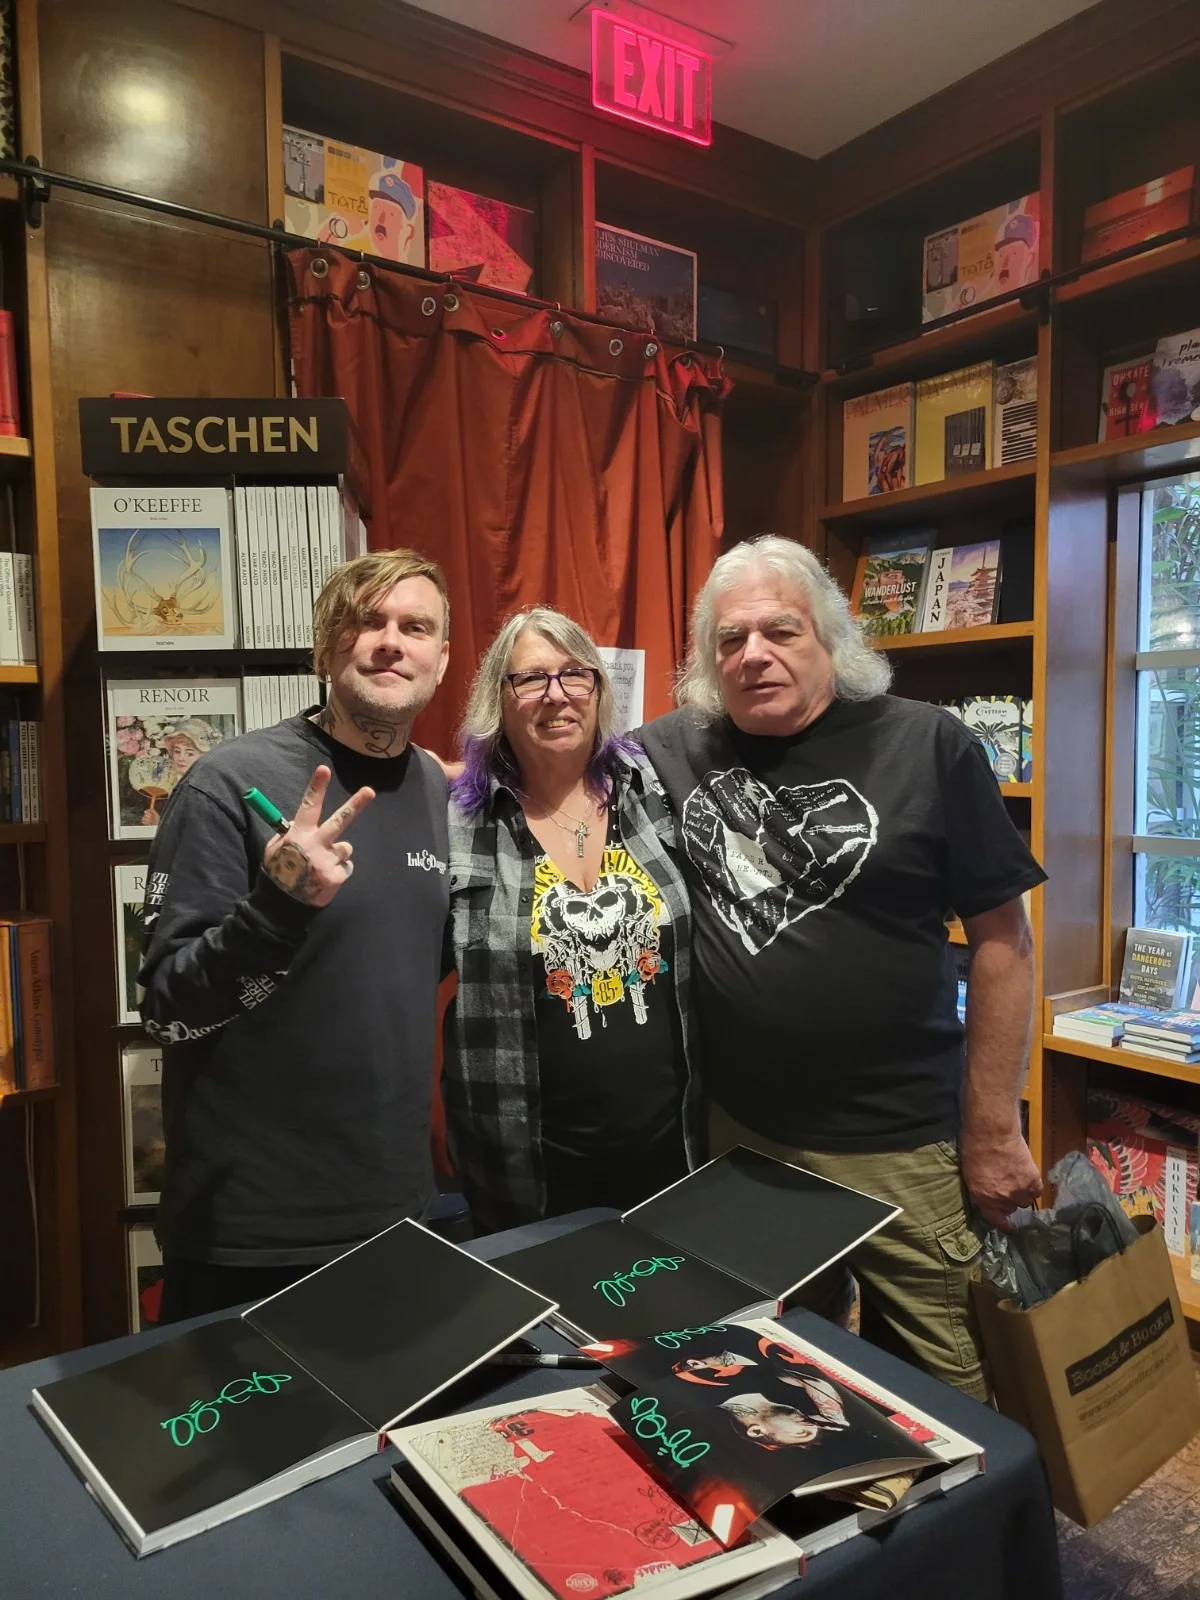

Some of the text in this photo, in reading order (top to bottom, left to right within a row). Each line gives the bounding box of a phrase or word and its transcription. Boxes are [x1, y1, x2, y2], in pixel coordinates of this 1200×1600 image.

[613, 25, 700, 129] EXIT
[596, 240, 638, 259] DERNISM
[618, 237, 659, 257] SHULMAN
[596, 249, 650, 272] DISCOVERED
[110, 416, 319, 454] TASCHEN
[863, 580, 918, 598] WANDERLUST
[929, 556, 946, 623] JAPAN
[139, 688, 210, 704] RENOIR
[1131, 952, 1172, 968] DANGEROUS
[1134, 943, 1147, 952] THE
[1148, 945, 1165, 957] YEAR
[30, 950, 39, 976] Anna
[1141, 964, 1158, 976] DAYS
[31, 977, 43, 1010] Atkins
[599, 980, 616, 1003] 85
[1171, 1161, 1181, 1236] HOKUSAI
[1120, 1341, 1130, 1357] &
